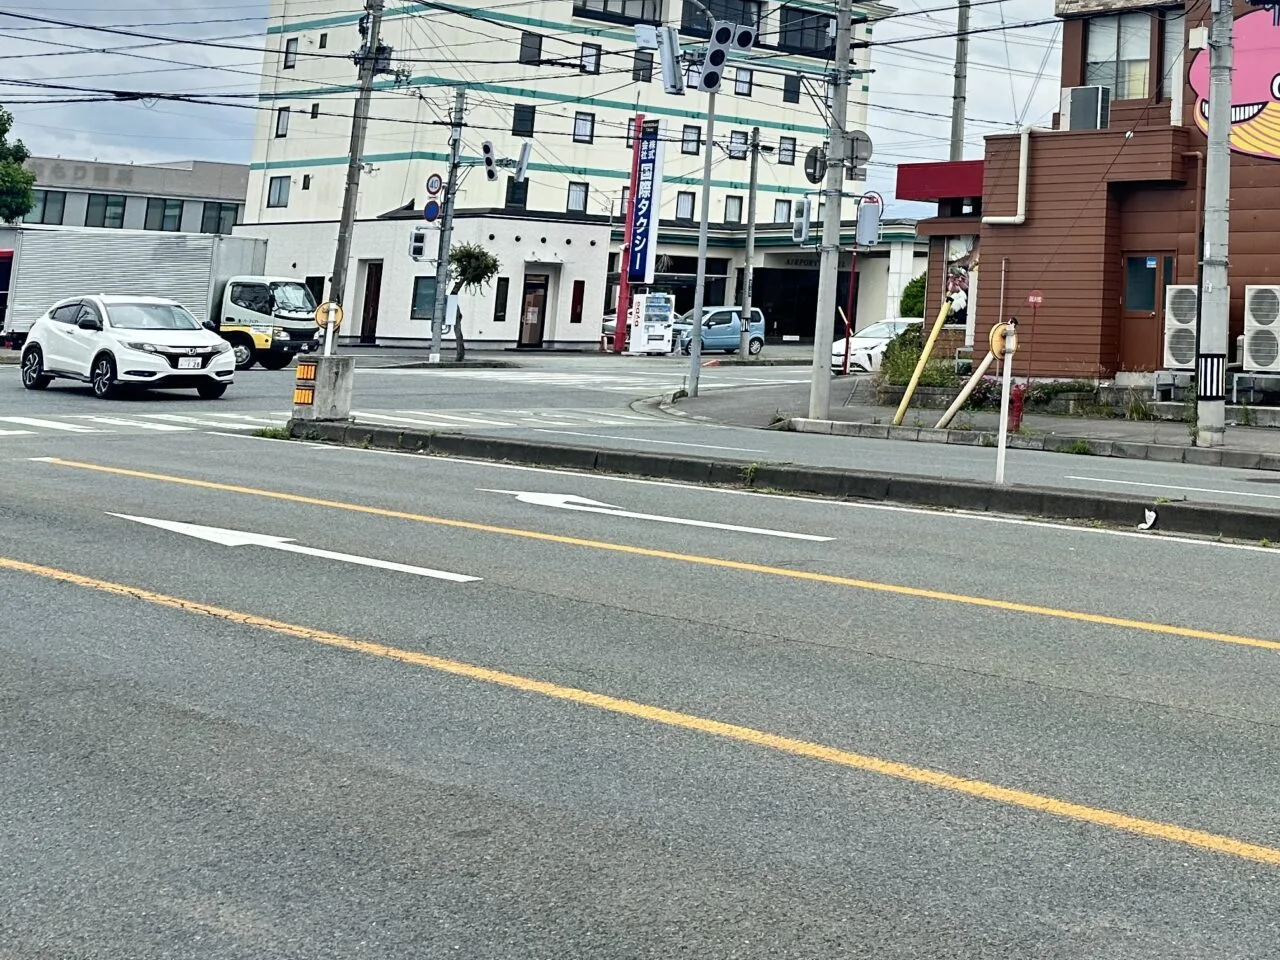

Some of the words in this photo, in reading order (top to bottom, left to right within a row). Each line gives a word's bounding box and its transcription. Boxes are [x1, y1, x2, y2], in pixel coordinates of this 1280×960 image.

[429, 179, 439, 189] 40
[635, 163, 653, 270] 国際タクシー
